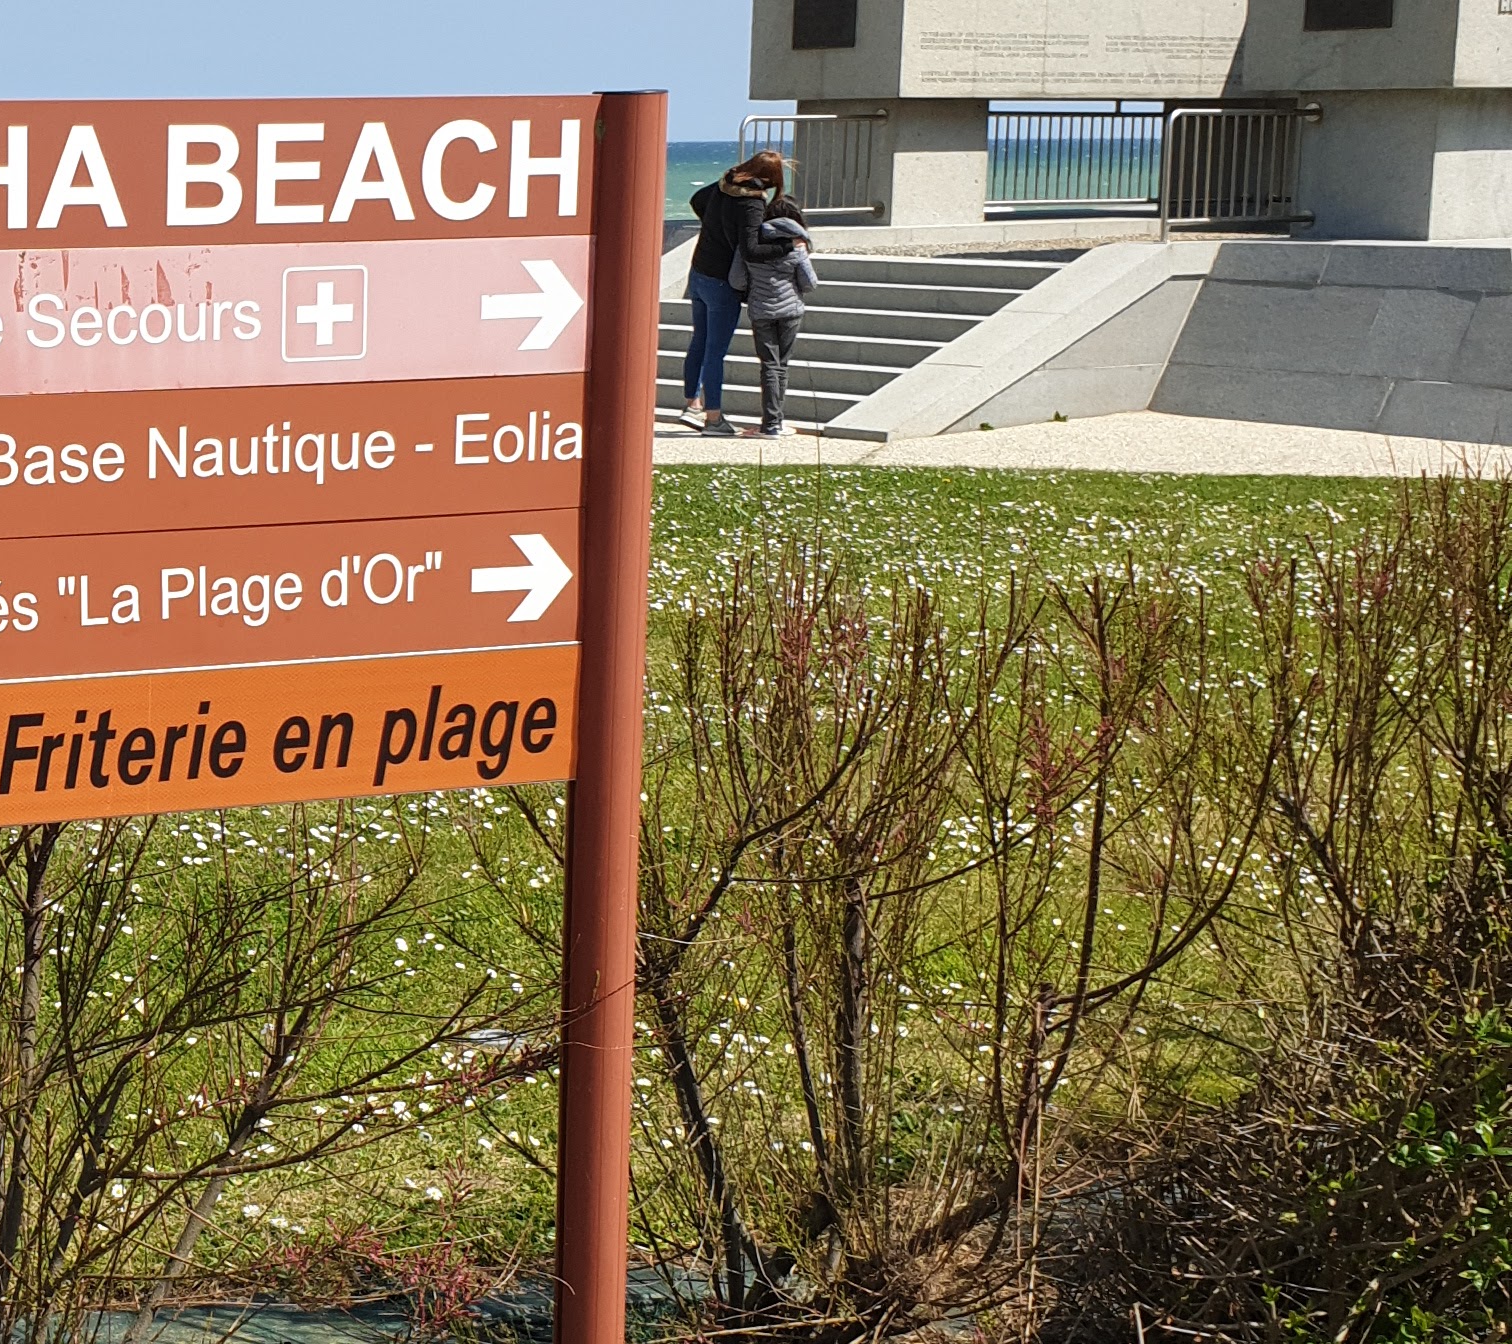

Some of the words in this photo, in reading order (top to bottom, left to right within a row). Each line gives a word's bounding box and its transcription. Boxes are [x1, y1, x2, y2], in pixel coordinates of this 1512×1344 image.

[166, 119, 581, 227] BEACH
[25, 293, 263, 349] Secours
[148, 421, 396, 485] Nautique
[454, 410, 583, 465] Eolia
[57, 575, 141, 627] "La
[161, 565, 303, 627] Plage
[320, 550, 443, 608] d'Or"
[274, 712, 354, 773] en
[374, 685, 557, 787] plage
